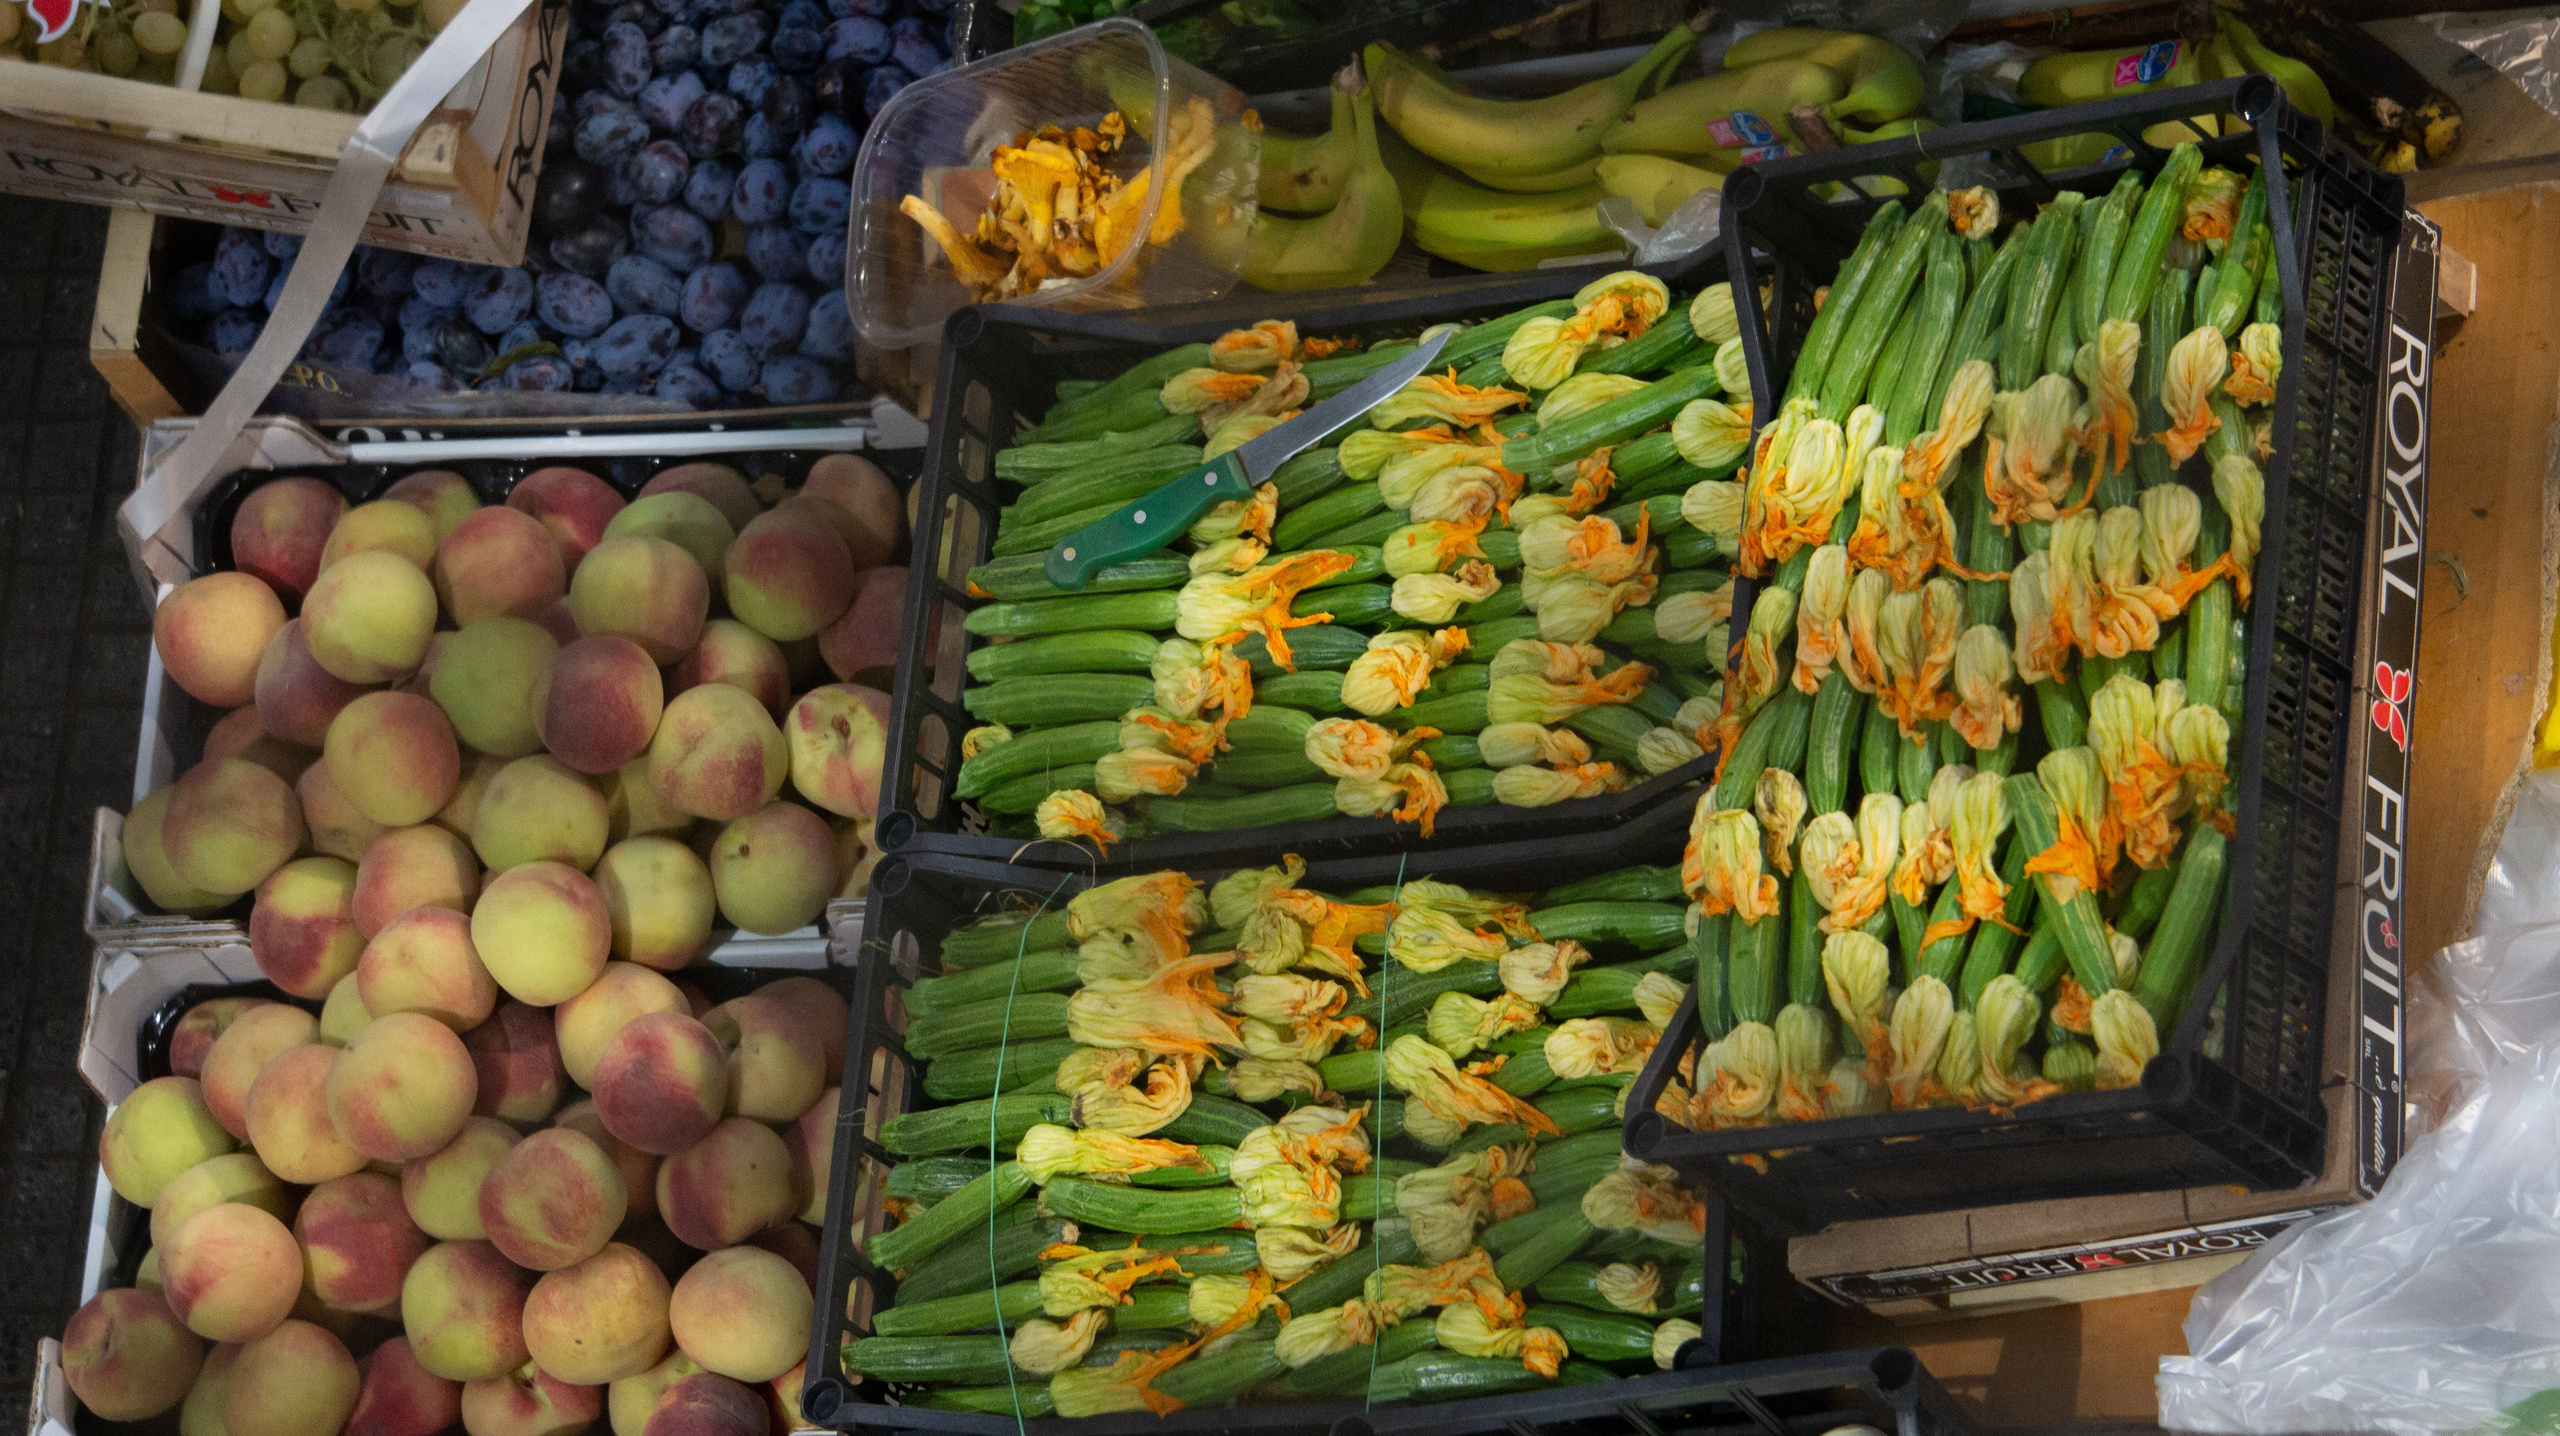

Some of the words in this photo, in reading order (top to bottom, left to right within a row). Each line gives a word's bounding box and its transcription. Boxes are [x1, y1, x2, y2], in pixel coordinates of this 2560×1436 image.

[5, 150, 224, 202] ROYAL
[2379, 323, 2428, 616] ROYAL
[2362, 774, 2404, 1078] FRUIT
[2364, 1037, 2372, 1059] SRL
[2371, 1094, 2387, 1176] qualità
[2113, 1229, 2270, 1262] ROYAL
[1947, 1258, 2079, 1288] FRUIT
